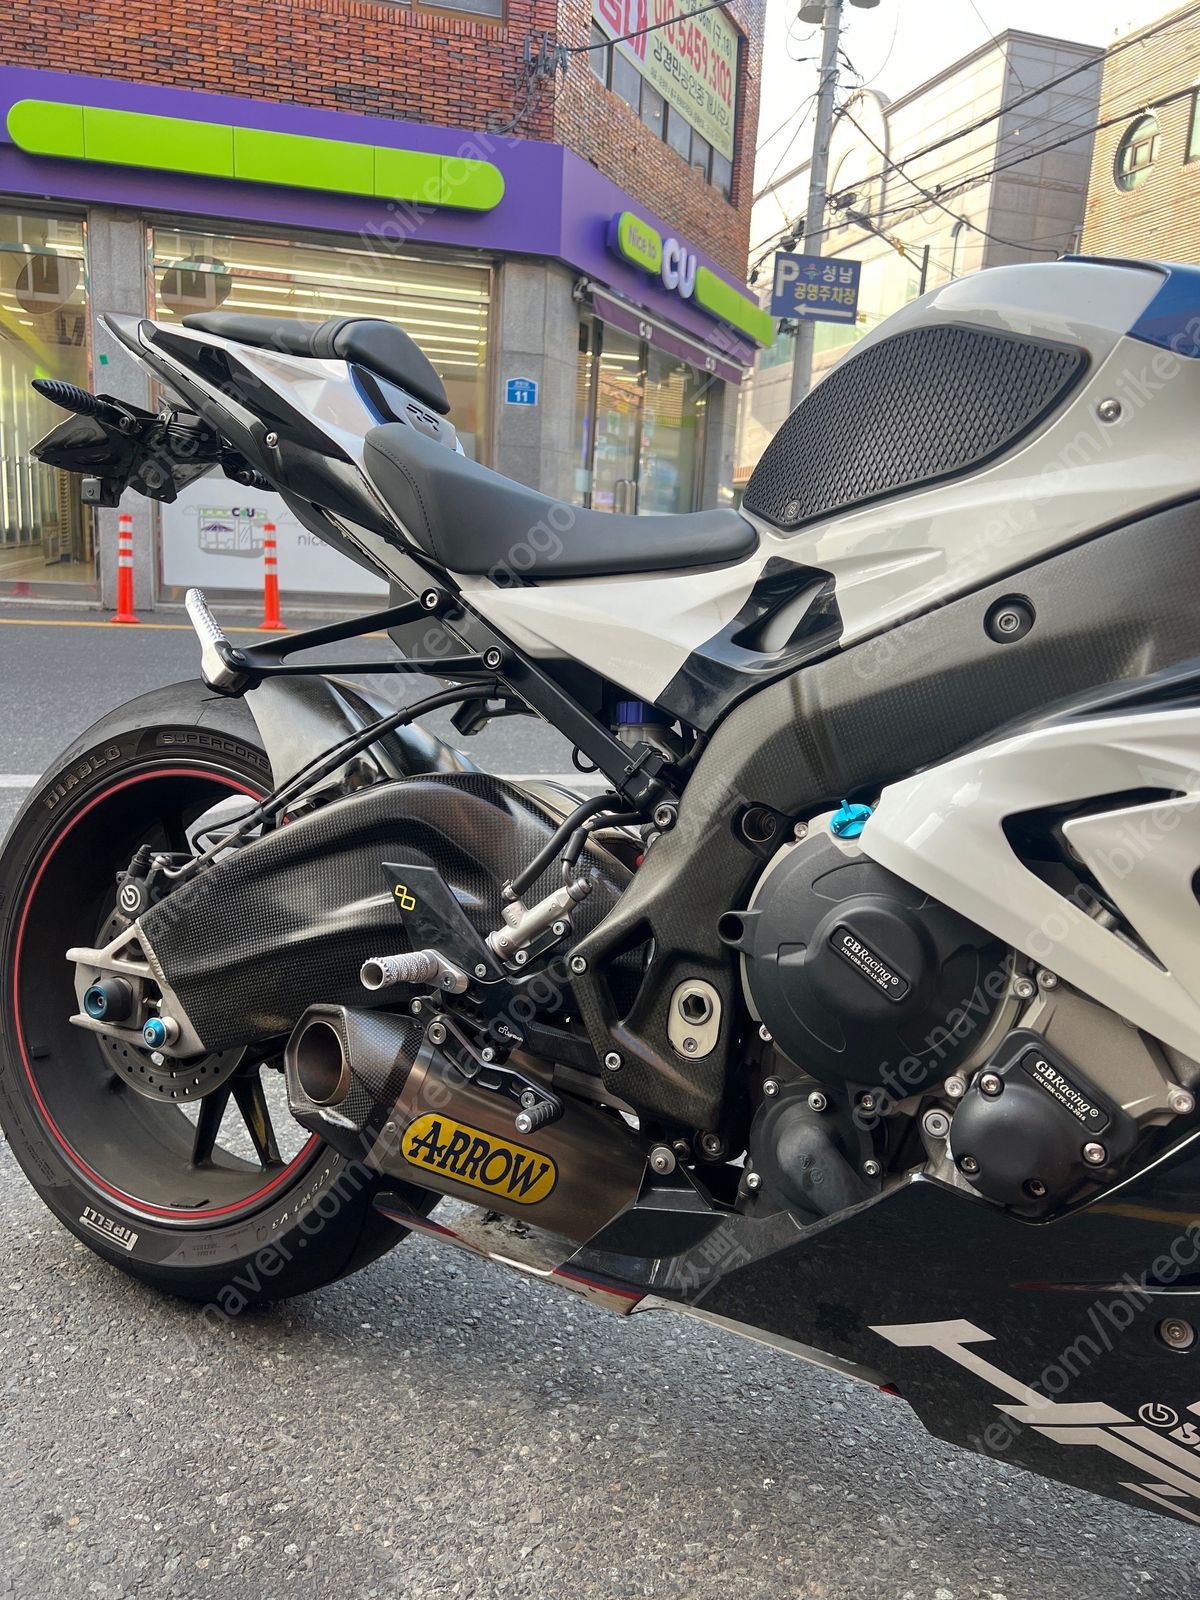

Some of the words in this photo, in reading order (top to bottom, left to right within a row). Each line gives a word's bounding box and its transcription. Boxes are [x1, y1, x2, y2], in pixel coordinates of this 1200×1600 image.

[662, 238, 697, 299] CU
[775, 259, 800, 297] P
[822, 265, 853, 284] 성남
[794, 282, 856, 305] 공영주차장
[514, 390, 529, 403] 11
[162, 733, 273, 773] SUPERCORS
[43, 745, 121, 809] DIABLO
[408, 1121, 550, 1197] ARROW
[79, 1206, 139, 1251] PIRELLI
